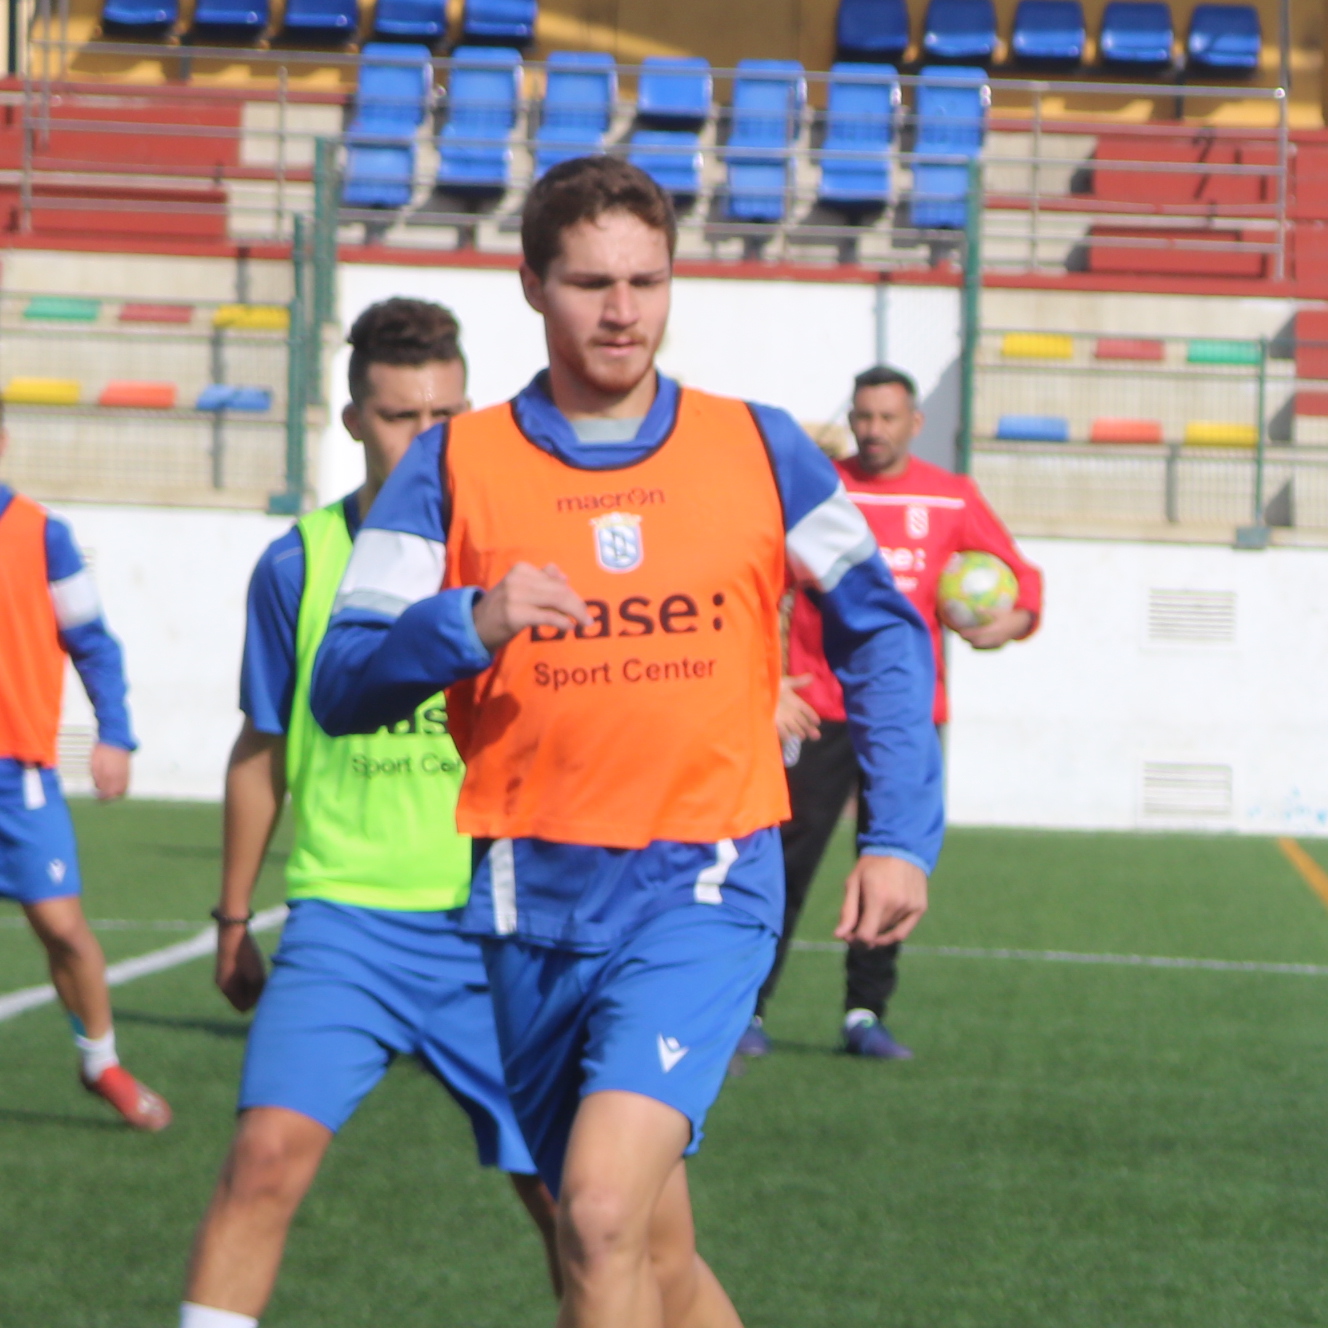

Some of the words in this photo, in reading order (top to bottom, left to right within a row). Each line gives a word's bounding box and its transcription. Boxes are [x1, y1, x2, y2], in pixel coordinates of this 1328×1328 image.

[556, 487, 666, 511] macron
[534, 660, 612, 691] Sport
[622, 656, 717, 683] Center
[352, 753, 413, 780] Sport
